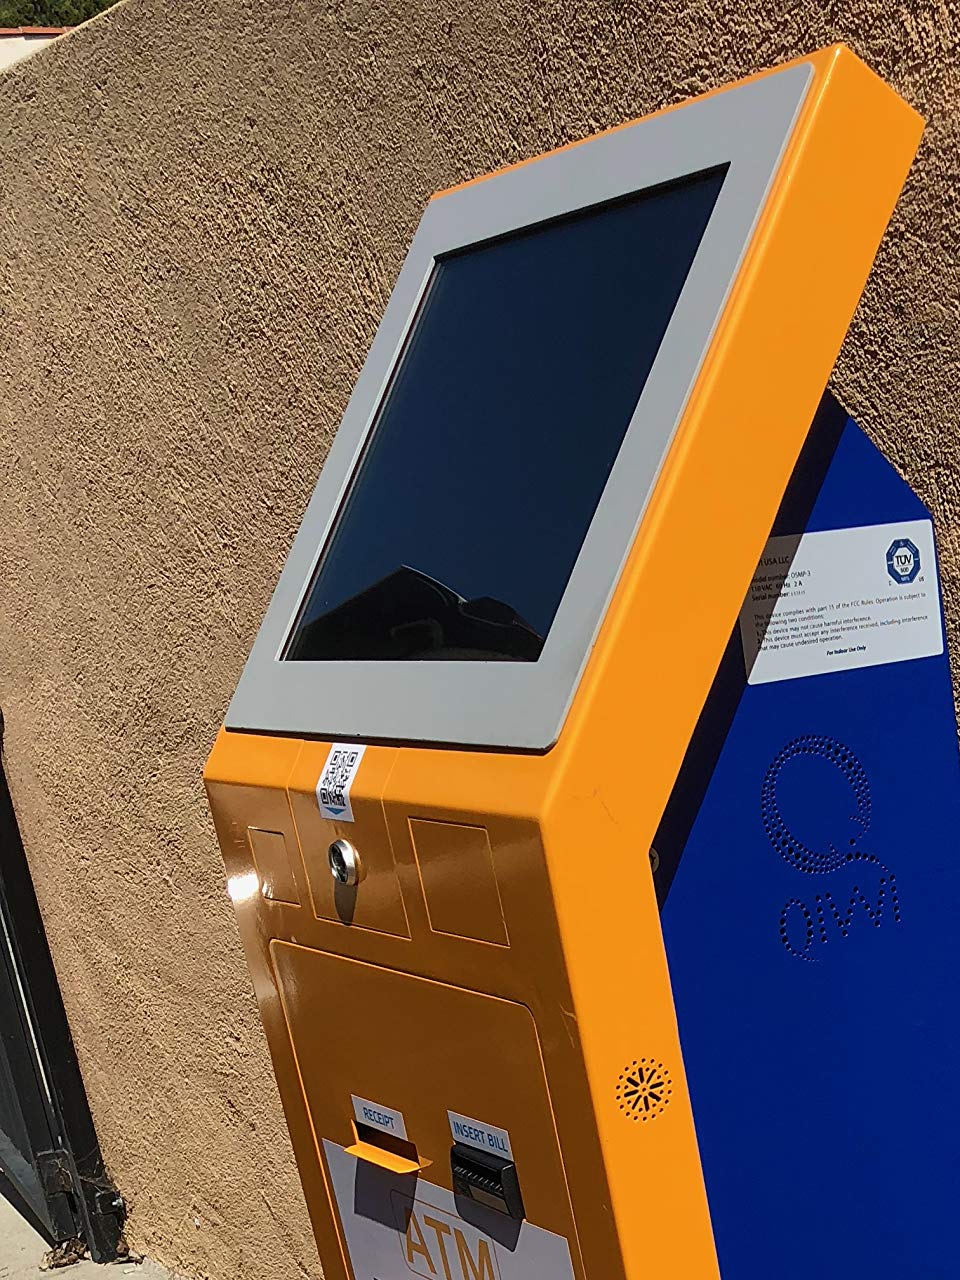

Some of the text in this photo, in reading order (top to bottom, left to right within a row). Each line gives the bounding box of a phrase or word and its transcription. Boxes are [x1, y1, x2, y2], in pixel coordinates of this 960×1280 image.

[764, 557, 777, 567] USA
[778, 556, 790, 564] LLC
[895, 554, 912, 565] TÜV
[783, 609, 804, 617] complies
[876, 596, 898, 604] Operation
[904, 594, 921, 602] subject
[804, 631, 820, 639] accept
[829, 625, 858, 634] interference
[880, 619, 901, 627] including
[901, 615, 928, 623] interference
[824, 619, 842, 627] harmful
[795, 638, 818, 646] undesired
[819, 634, 843, 644] operation.
[834, 648, 847, 656] Indoor
[779, 874, 903, 963] QIWI
[363, 1107, 394, 1130] RECEIPT
[453, 1121, 508, 1152] INSERT BILL
